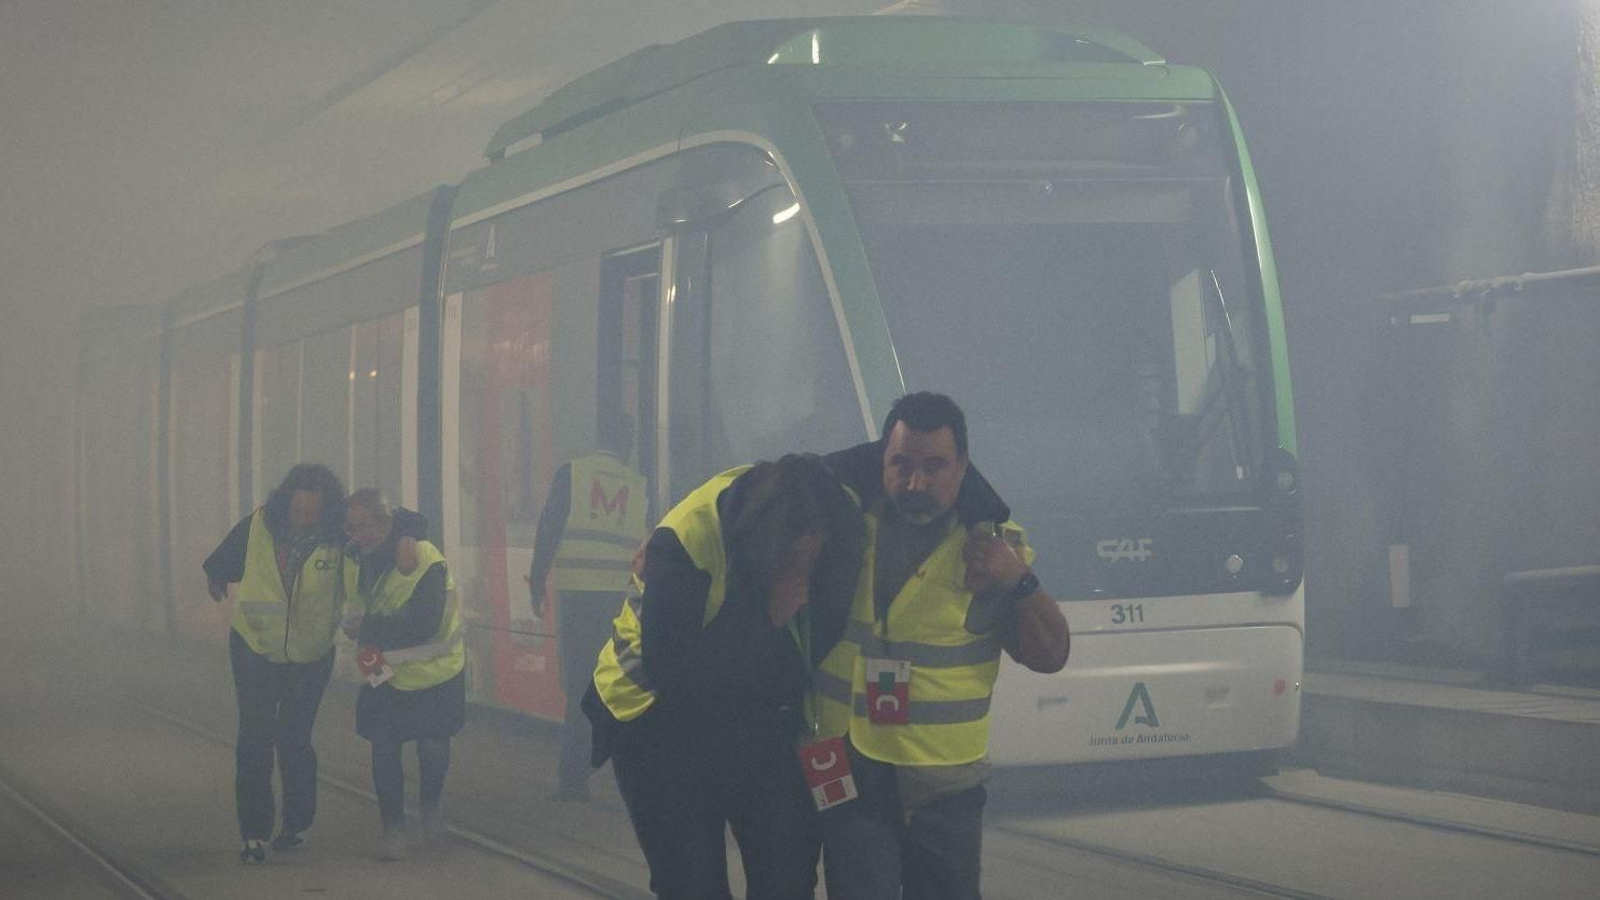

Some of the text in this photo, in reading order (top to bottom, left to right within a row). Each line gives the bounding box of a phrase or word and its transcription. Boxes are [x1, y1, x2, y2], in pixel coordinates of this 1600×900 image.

[590, 478, 630, 523] M
[1096, 537, 1153, 563] CAF
[1110, 603, 1145, 624] 311
[1087, 734, 1117, 747] Junta
[1120, 733, 1134, 745] de
